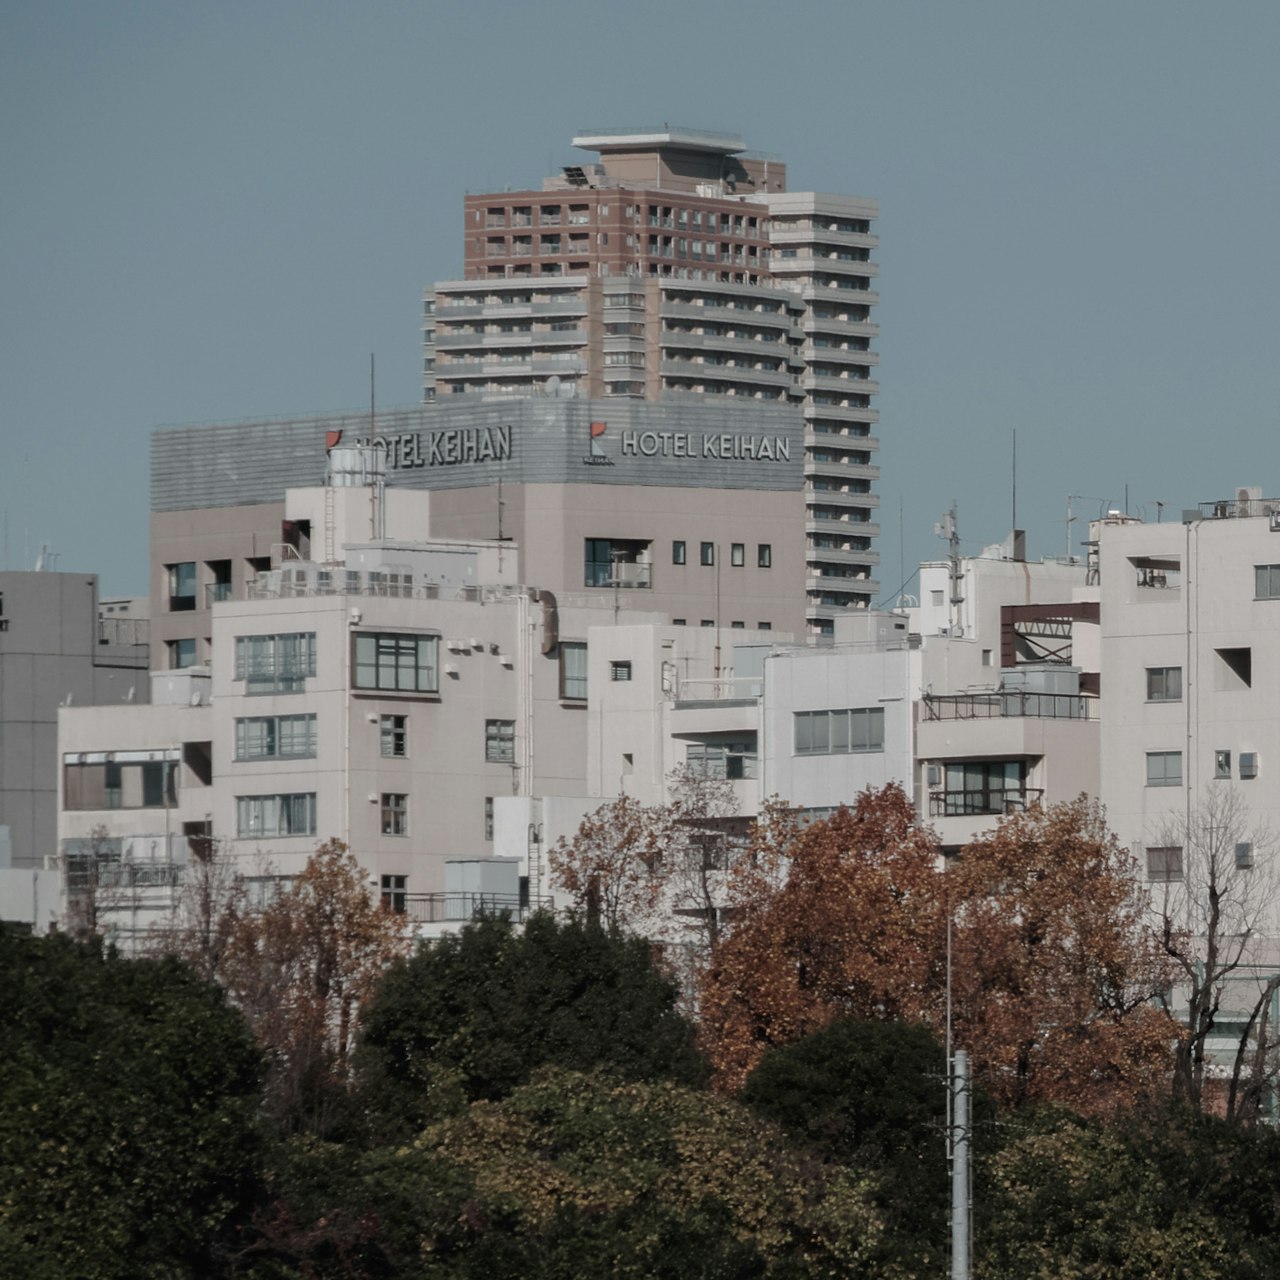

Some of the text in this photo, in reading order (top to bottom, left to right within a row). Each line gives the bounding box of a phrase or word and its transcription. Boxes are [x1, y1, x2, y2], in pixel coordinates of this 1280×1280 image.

[429, 425, 513, 467] KEIHAN
[621, 430, 791, 462] HOTEL KEIHAN
